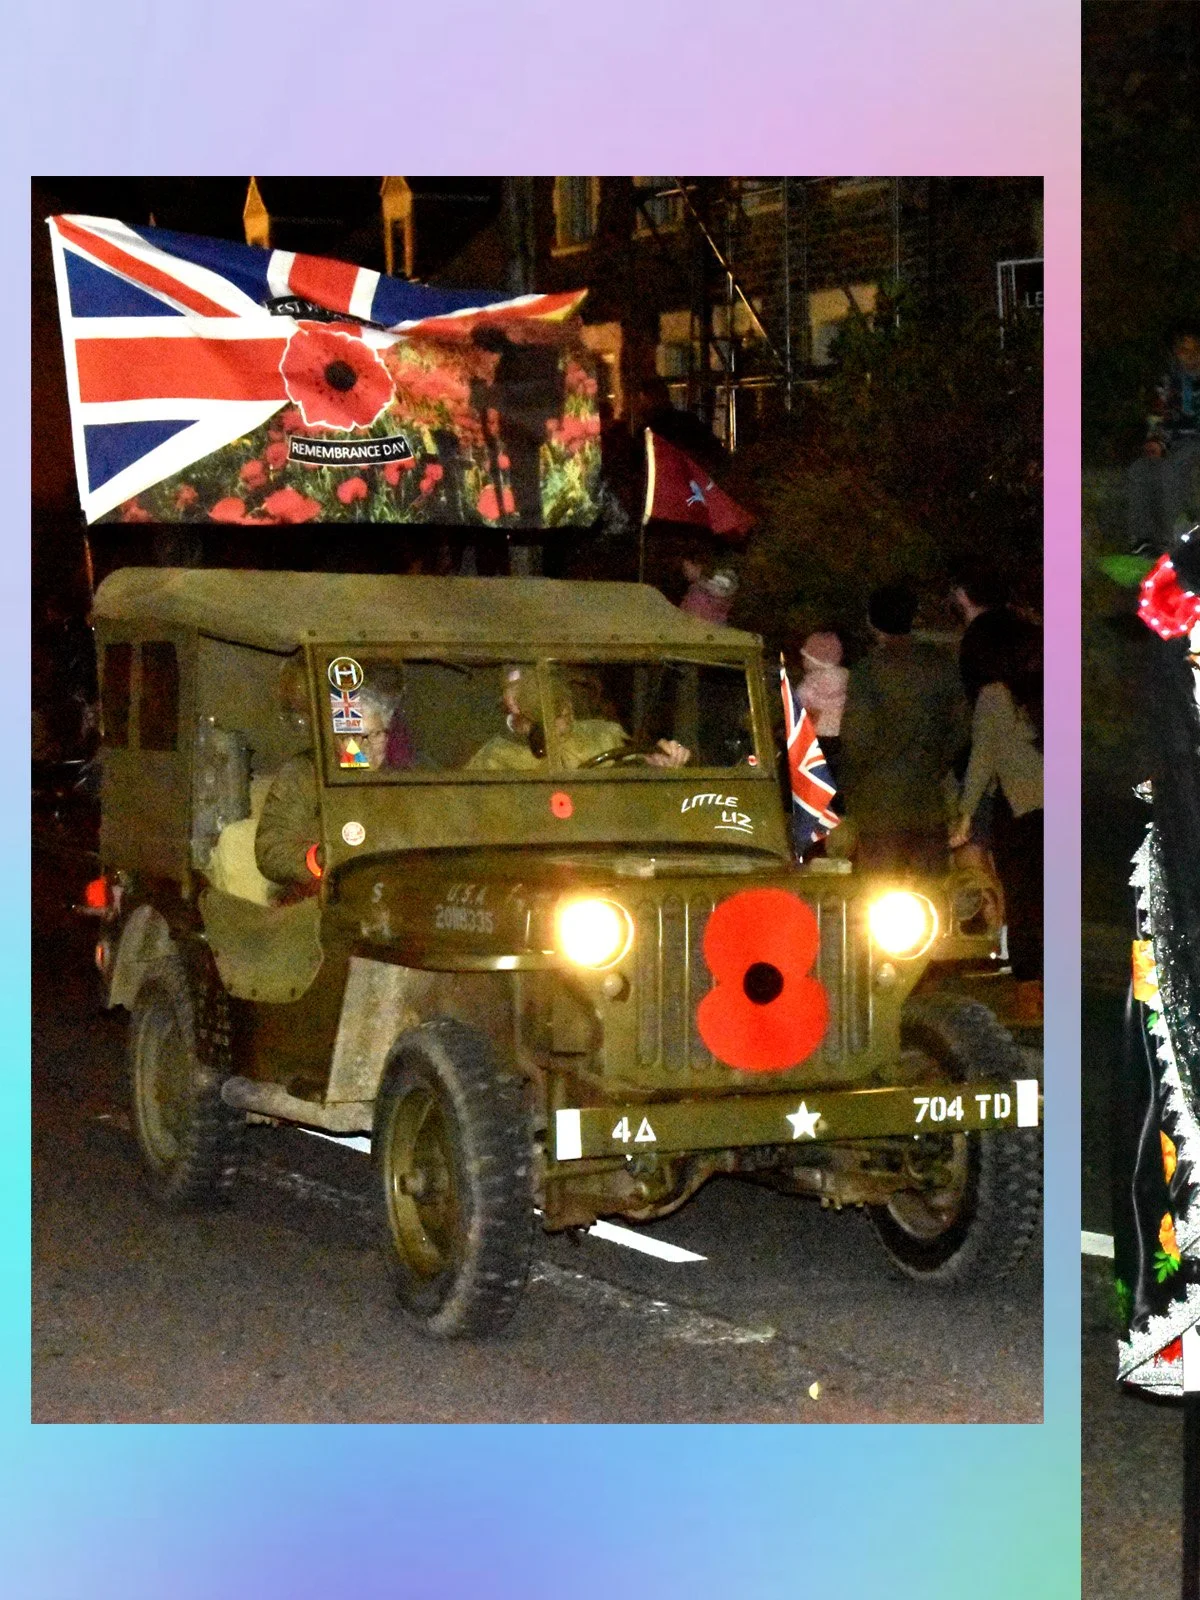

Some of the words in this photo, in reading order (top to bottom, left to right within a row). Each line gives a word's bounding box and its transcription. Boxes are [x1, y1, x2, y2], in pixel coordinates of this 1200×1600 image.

[292, 441, 381, 459] REMEMBRANCE
[383, 441, 406, 455] DAY
[681, 793, 739, 813] LITTLE
[722, 809, 754, 830] LIZ
[913, 1095, 965, 1123] 704
[975, 1092, 1011, 1120] TD
